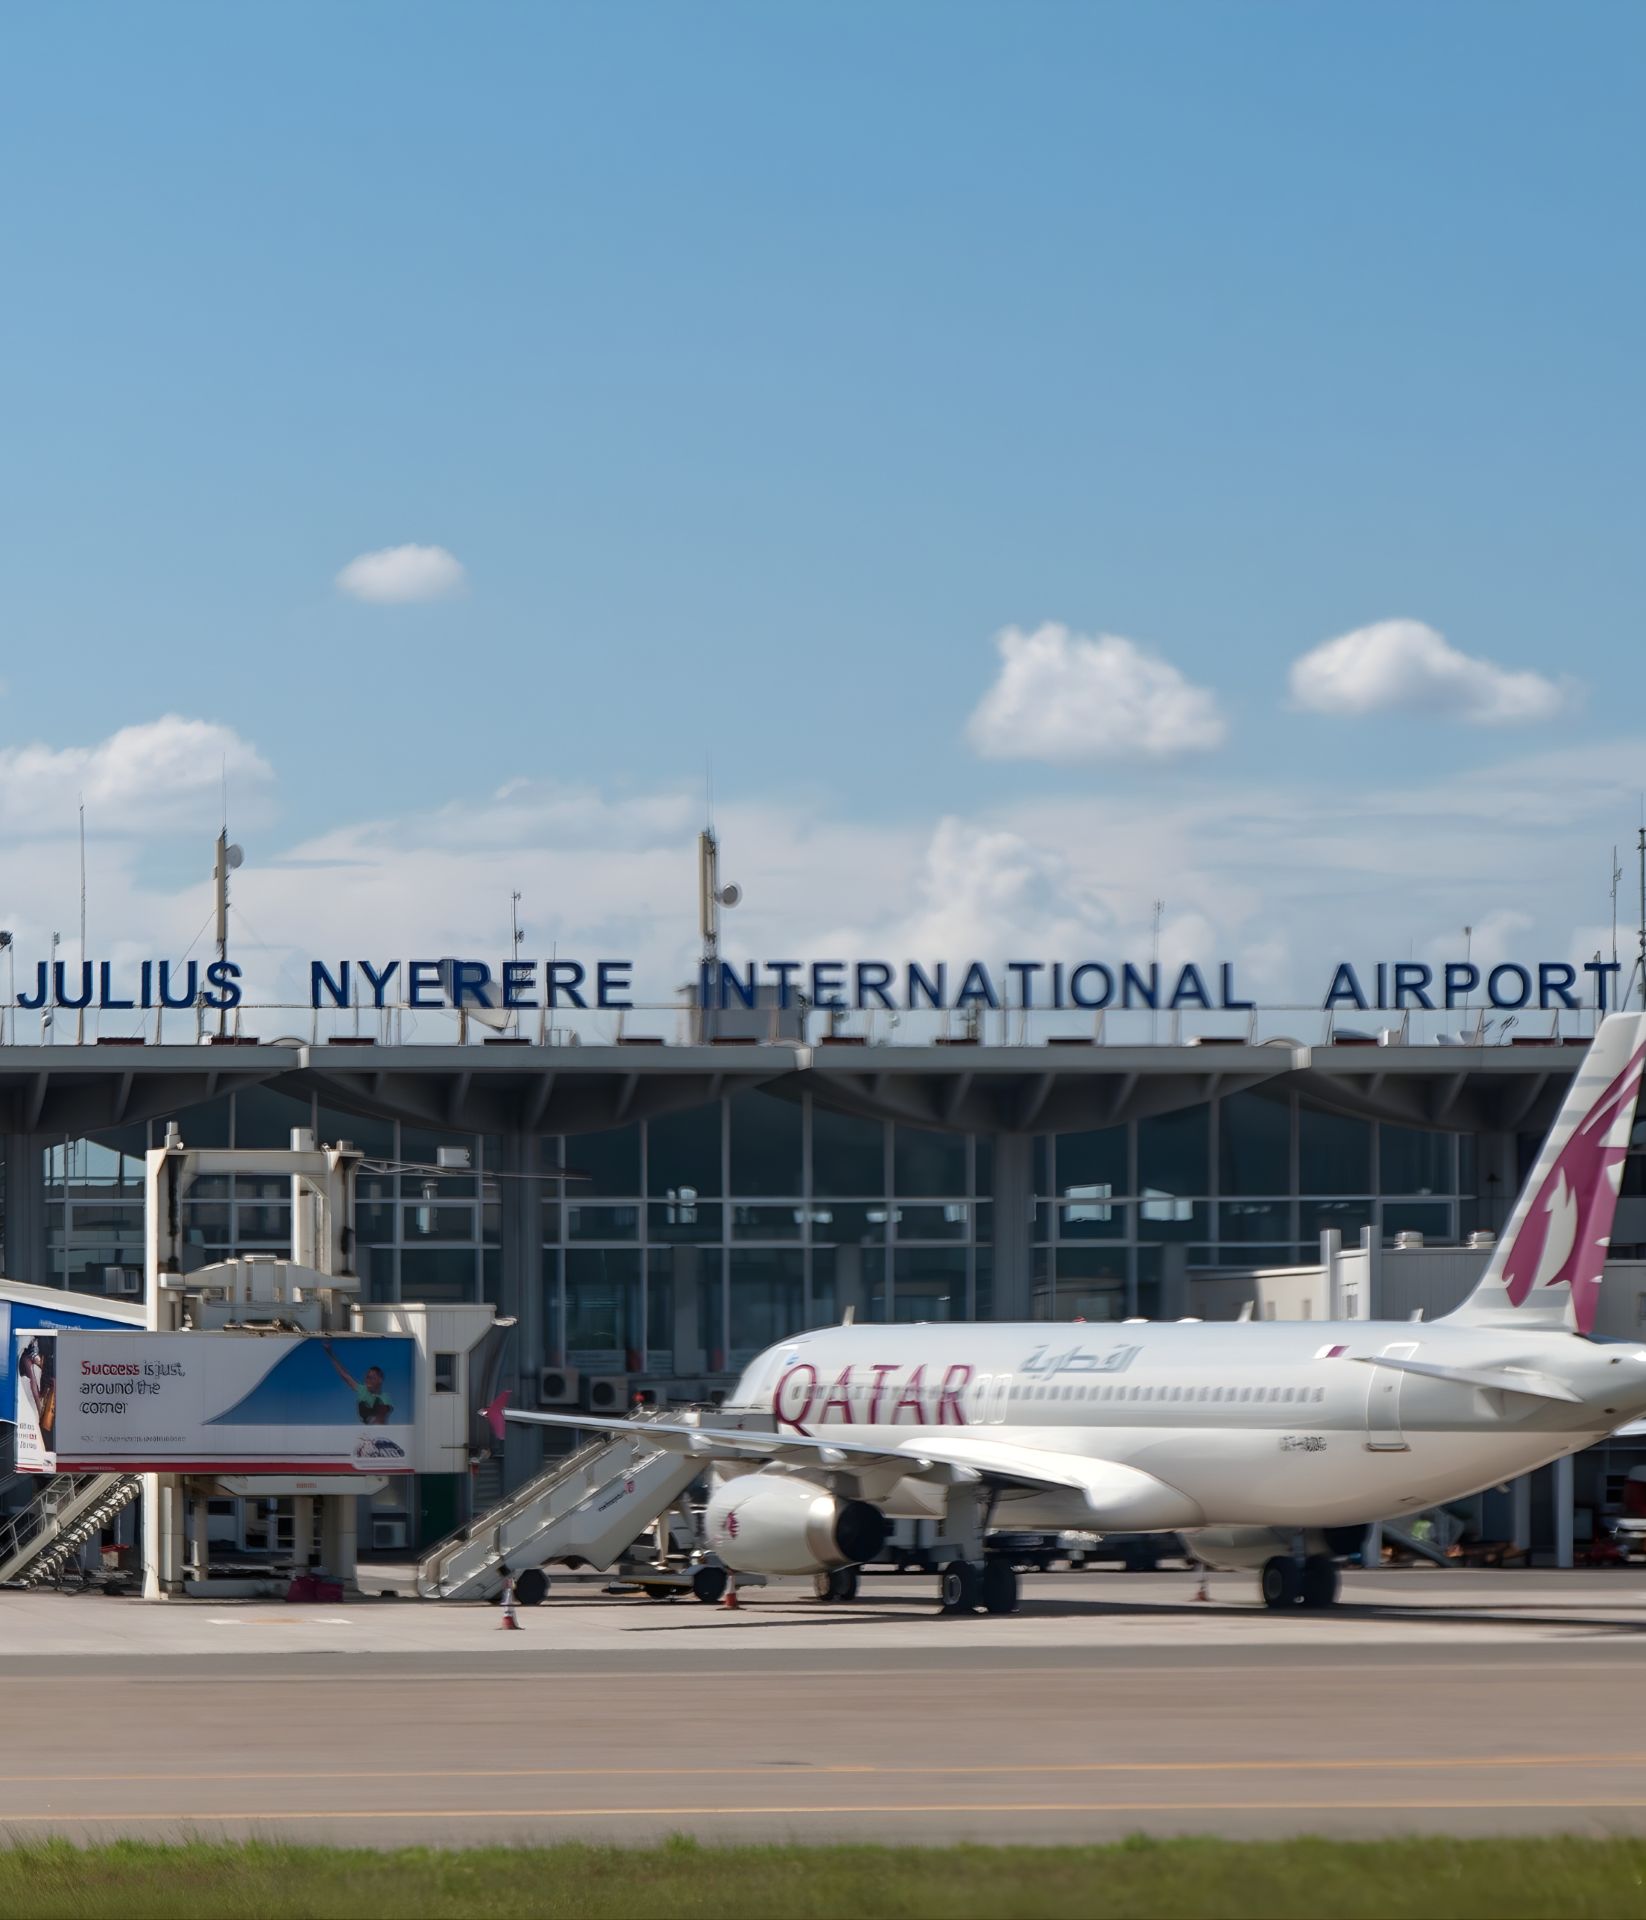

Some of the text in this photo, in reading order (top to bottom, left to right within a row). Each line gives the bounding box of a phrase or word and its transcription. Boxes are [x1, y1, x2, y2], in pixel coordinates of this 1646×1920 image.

[16, 959, 1622, 1011] JULIUS NYERERE INTERNATIONAL AIRPORT
[81, 1360, 140, 1376] Success
[144, 1361, 154, 1376] is
[80, 1379, 134, 1395] around
[773, 1363, 975, 1437] QATAR
